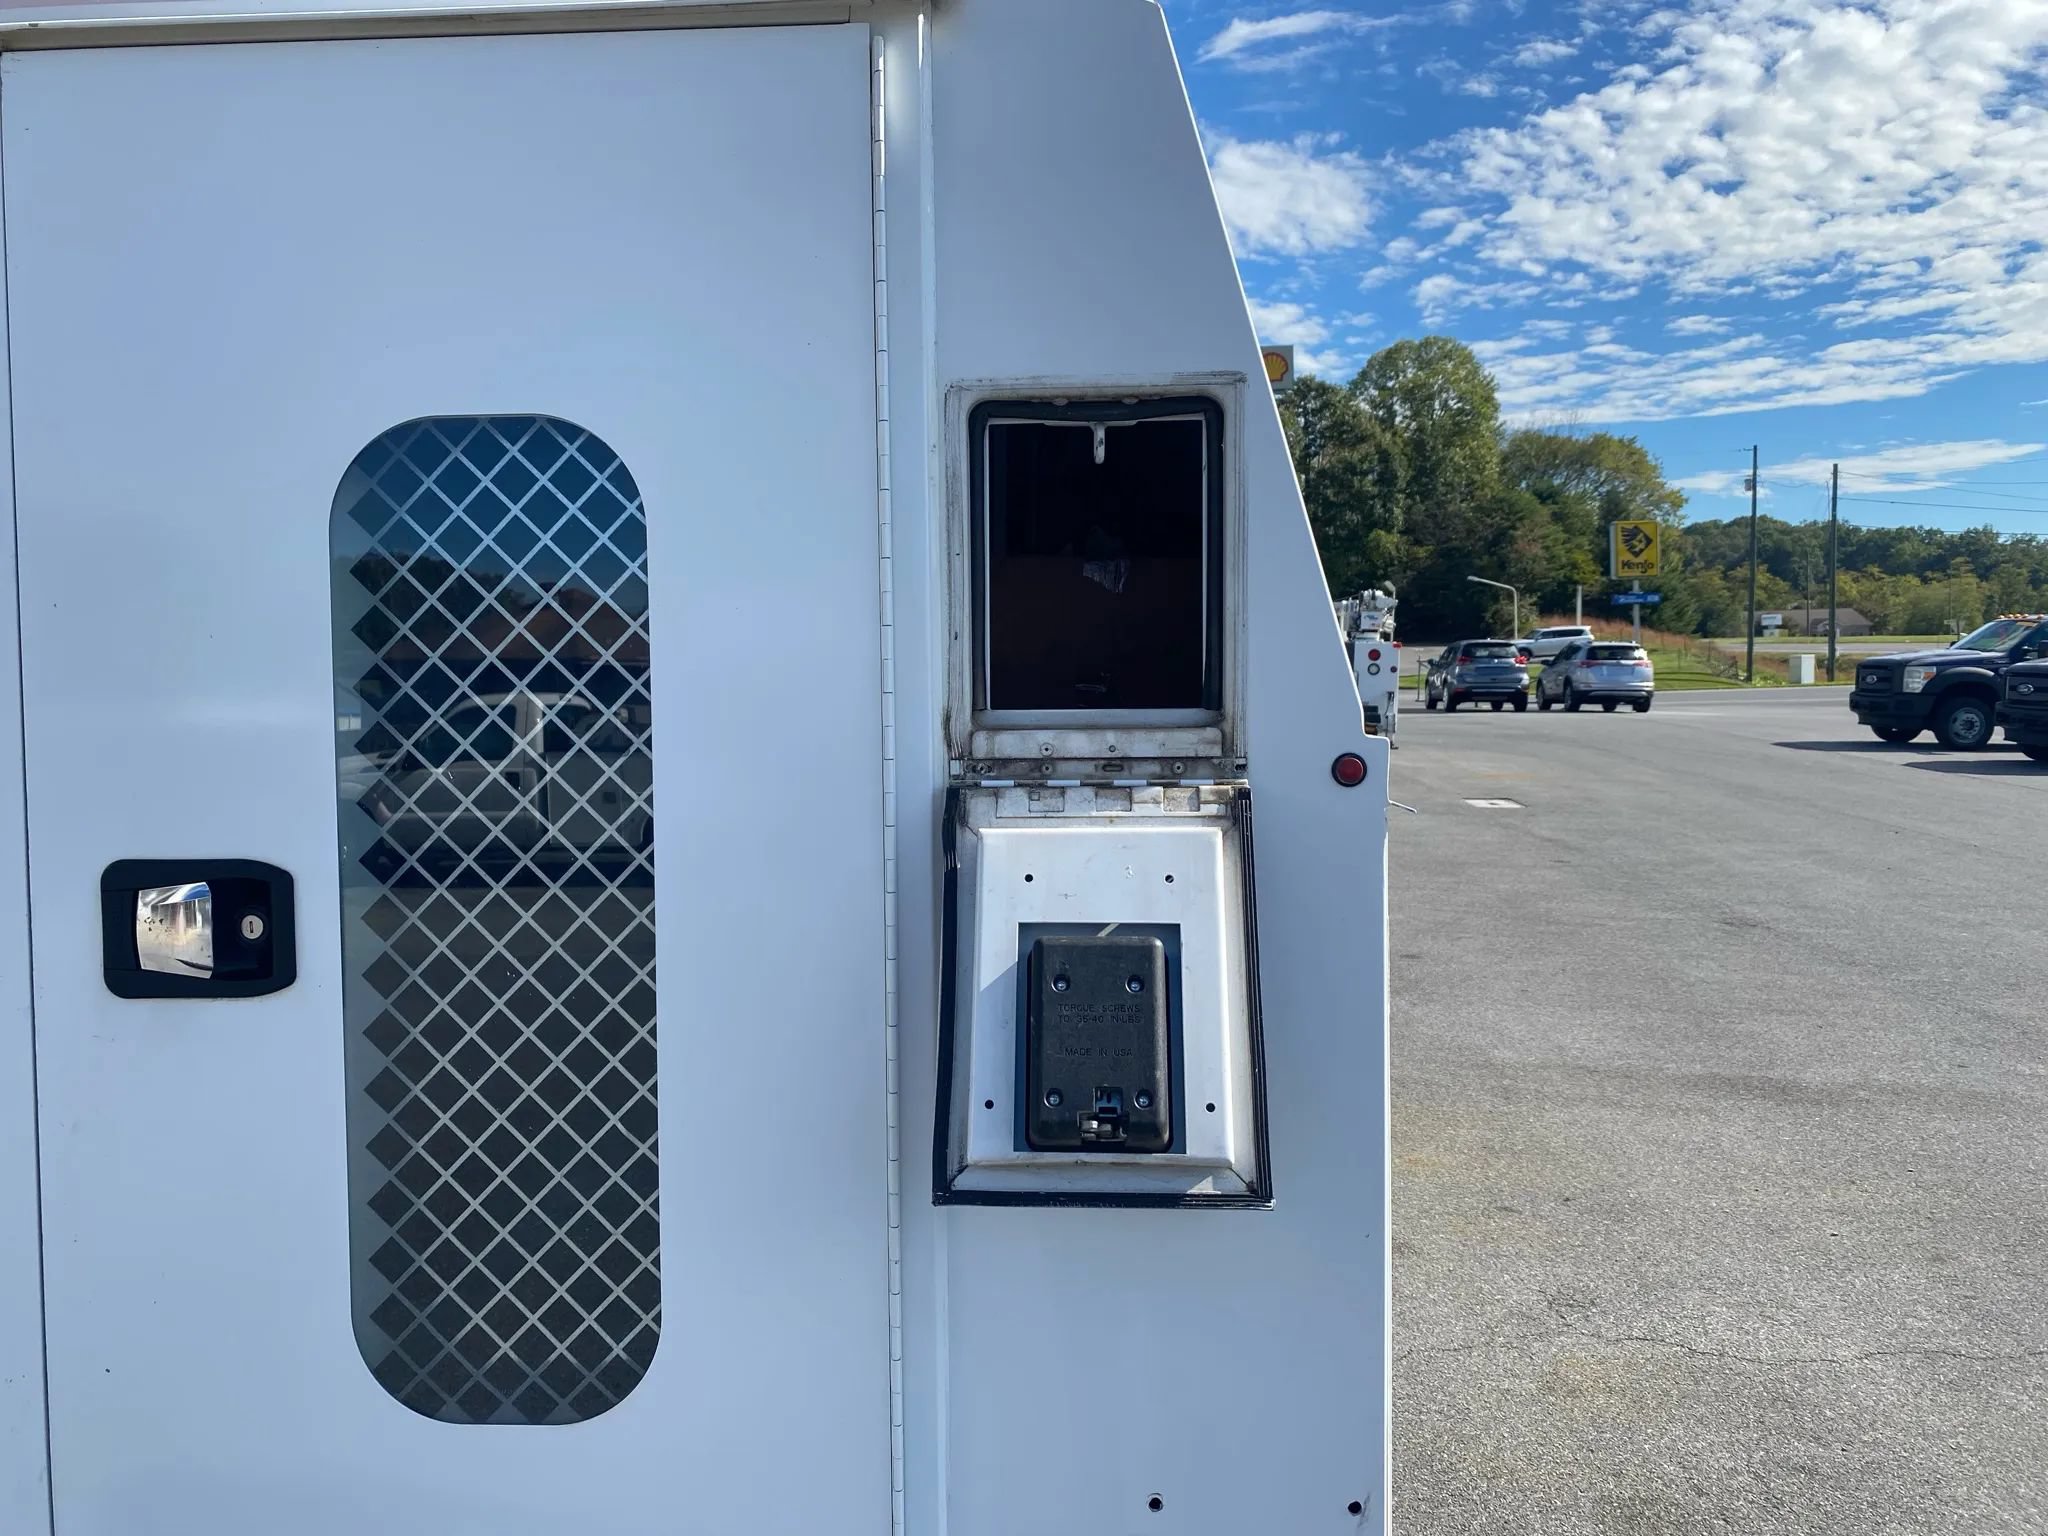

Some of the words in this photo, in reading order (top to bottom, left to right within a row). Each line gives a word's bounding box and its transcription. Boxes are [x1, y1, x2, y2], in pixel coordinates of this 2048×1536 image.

[1058, 1004, 1094, 1012] TORQUE
[1102, 1004, 1141, 1013] SCREWS
[1058, 1014, 1070, 1024] TO
[1065, 1047, 1092, 1056] MADE
[1098, 1047, 1108, 1057] IN
[1113, 1047, 1133, 1056] USA
